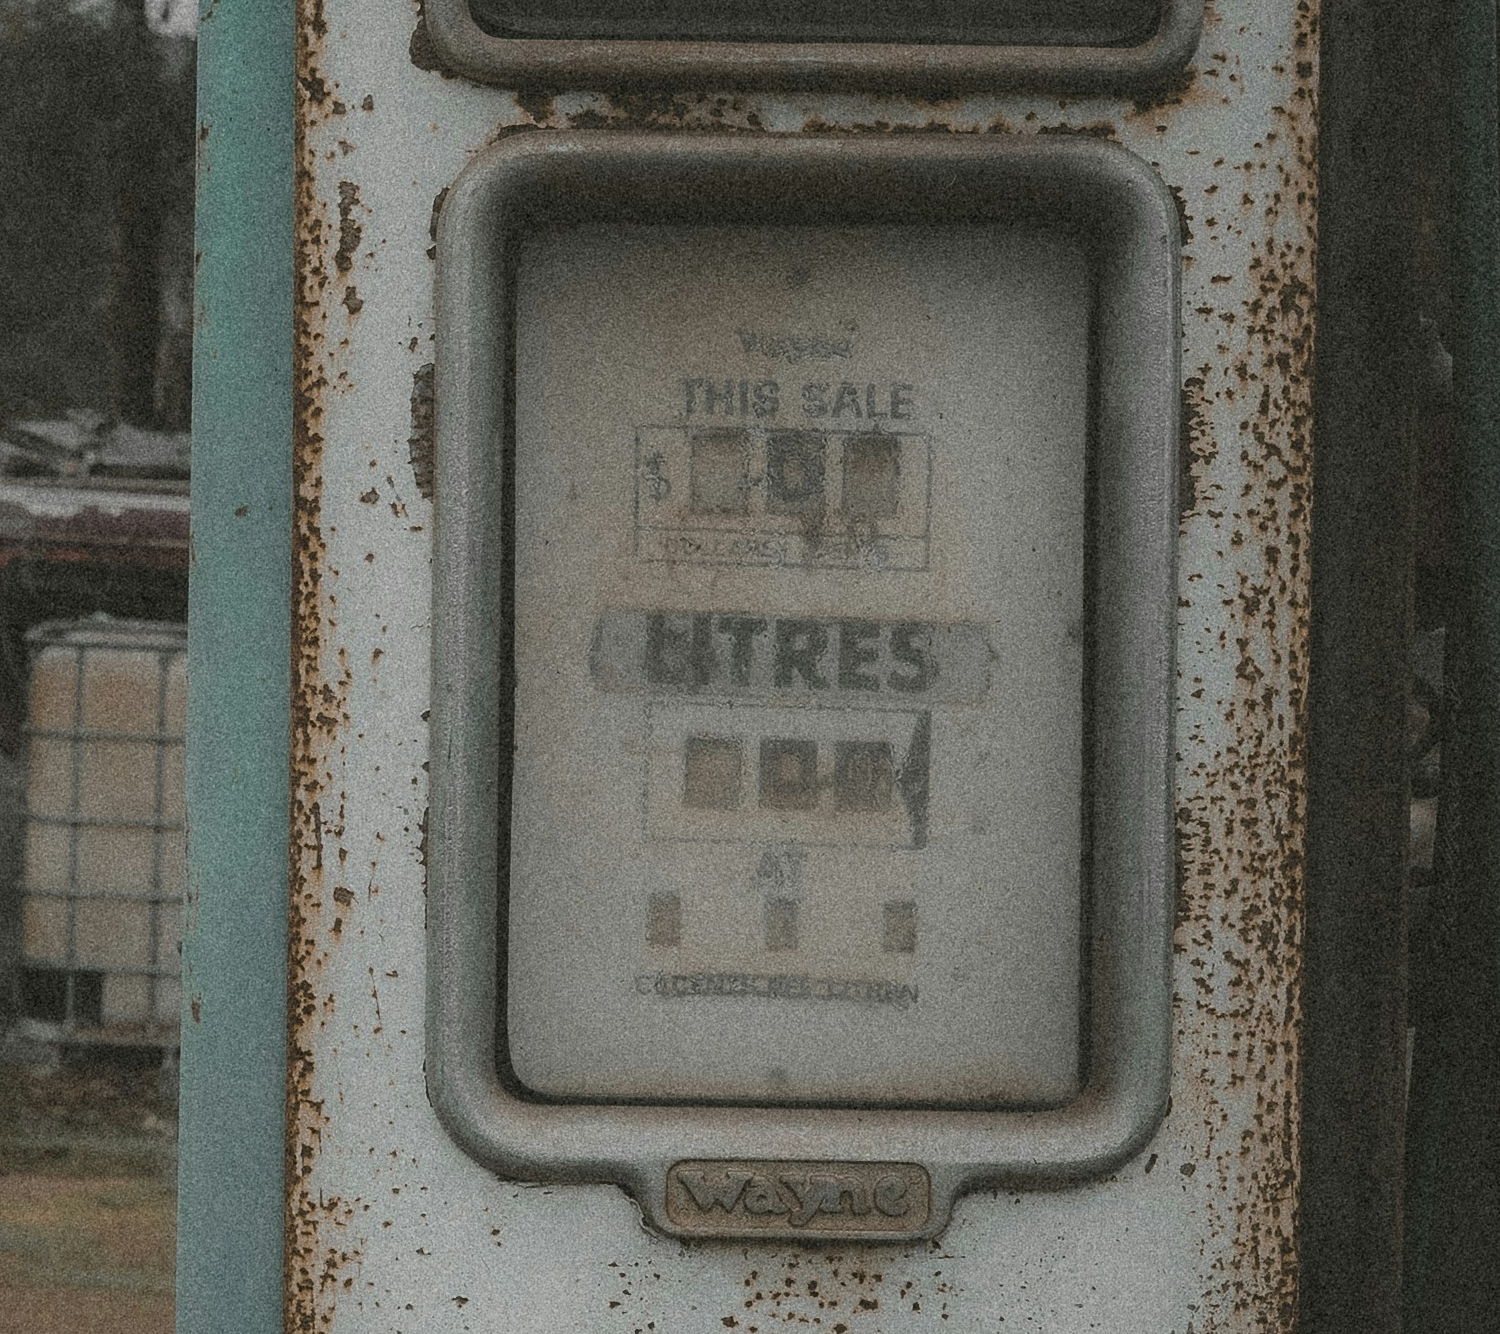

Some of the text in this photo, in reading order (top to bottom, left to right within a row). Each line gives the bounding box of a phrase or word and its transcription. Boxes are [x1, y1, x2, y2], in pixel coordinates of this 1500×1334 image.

[681, 376, 915, 421] THIS SALE
[644, 609, 941, 693] LITRES
[676, 1172, 911, 1227] Wayne
